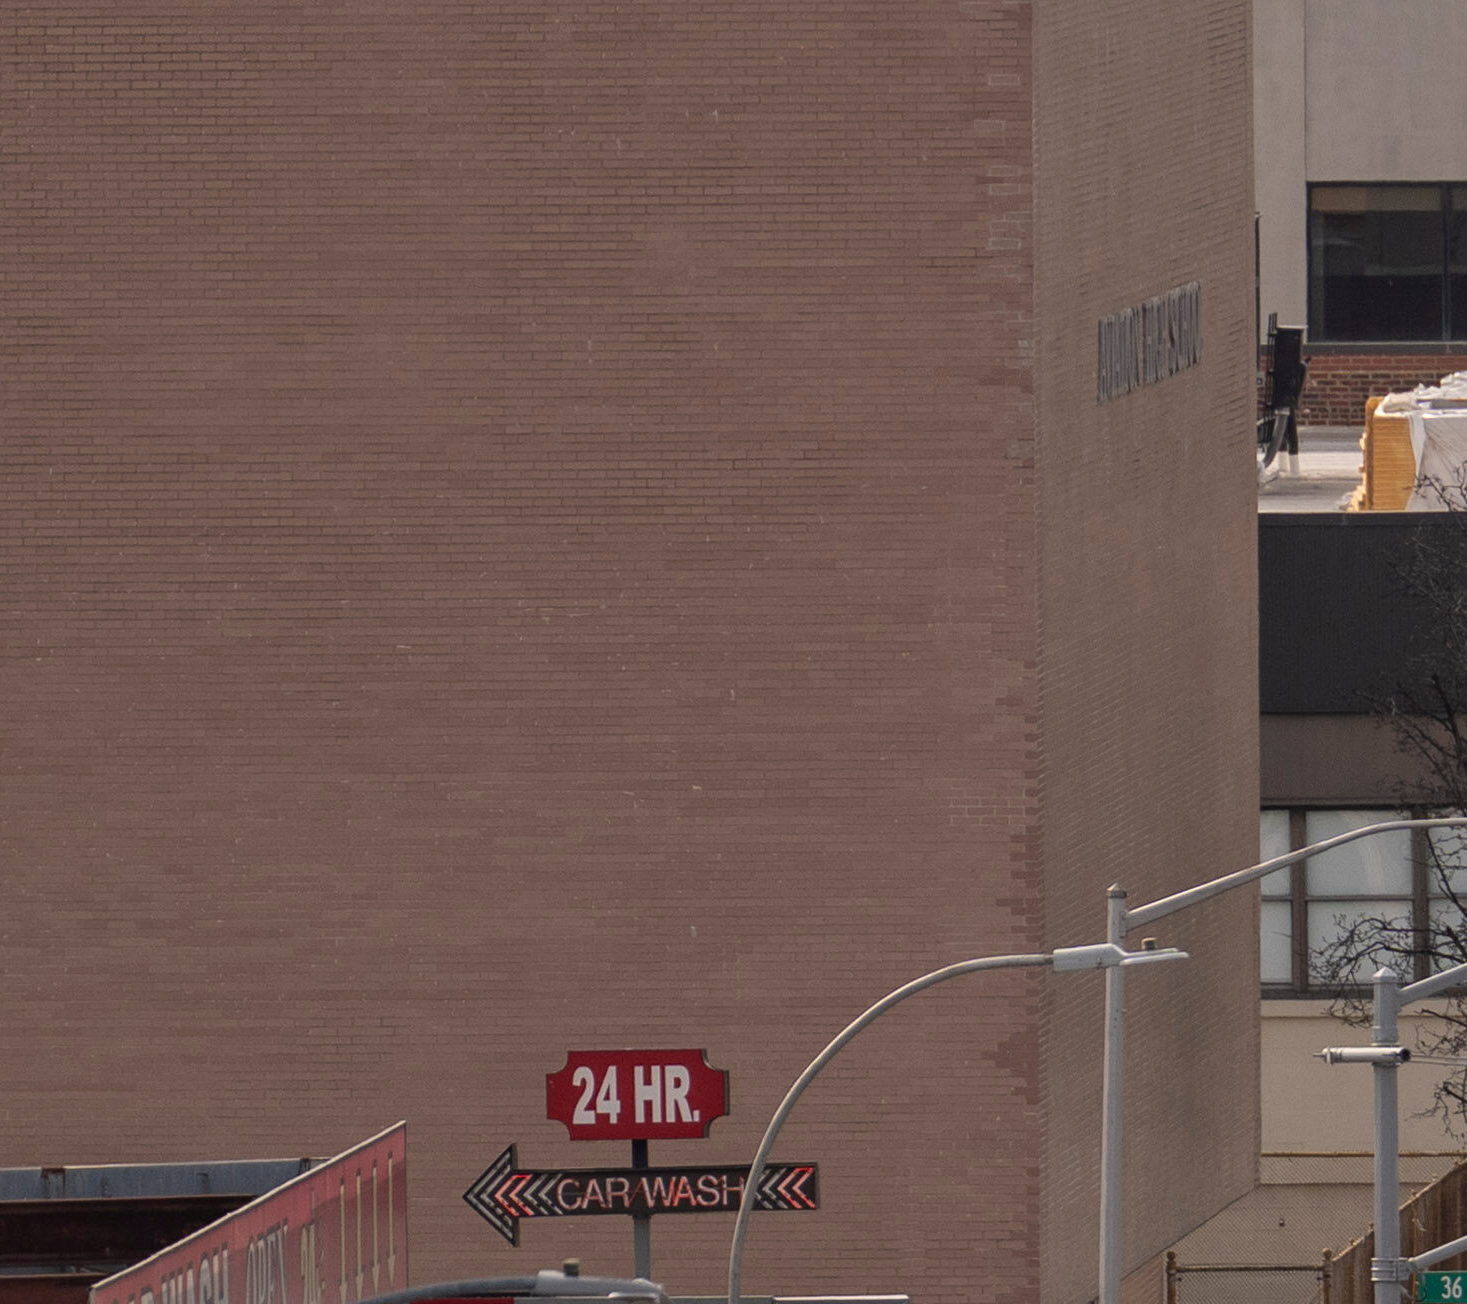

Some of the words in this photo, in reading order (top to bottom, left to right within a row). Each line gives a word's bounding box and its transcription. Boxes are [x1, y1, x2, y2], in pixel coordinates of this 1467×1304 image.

[571, 1065, 621, 1125] 24
[633, 1064, 701, 1124] HR.
[556, 1178, 631, 1210] CAR
[638, 1174, 745, 1208] WASH
[1441, 1275, 1464, 1300] 36
